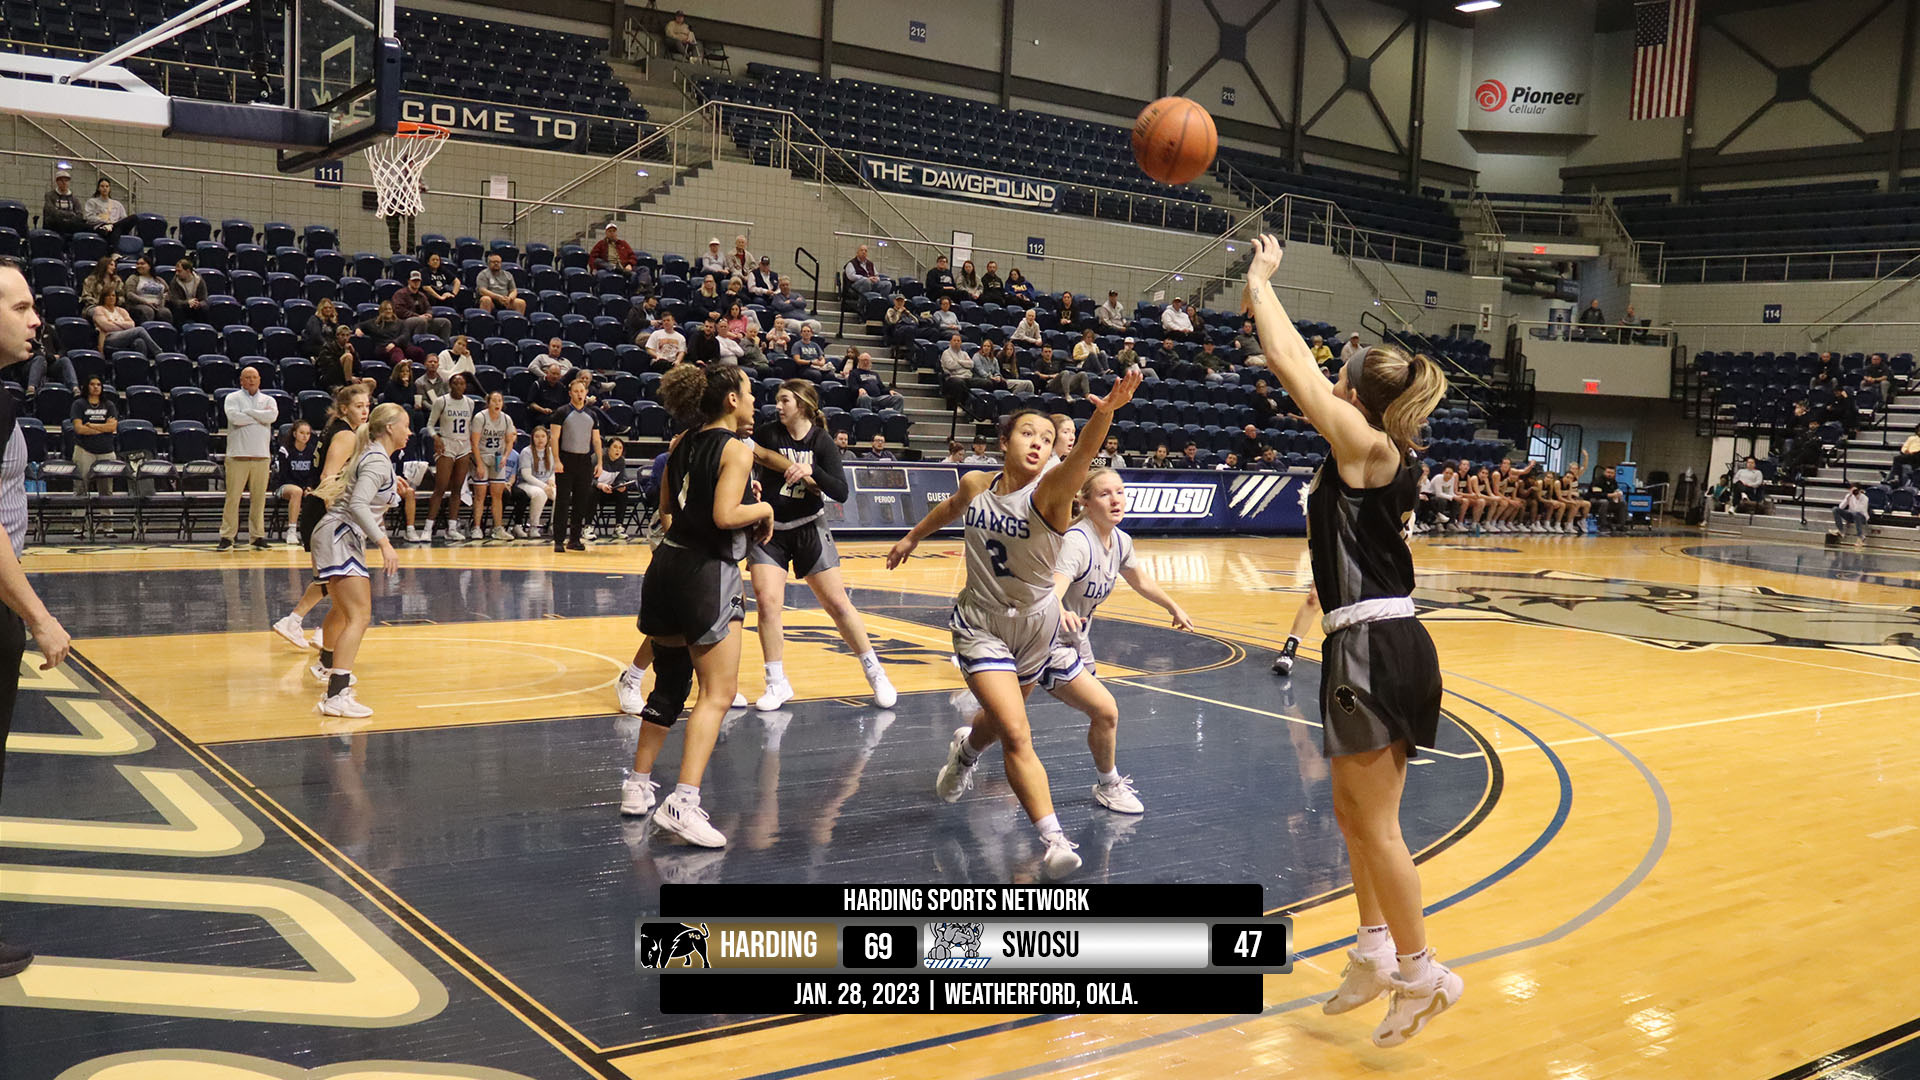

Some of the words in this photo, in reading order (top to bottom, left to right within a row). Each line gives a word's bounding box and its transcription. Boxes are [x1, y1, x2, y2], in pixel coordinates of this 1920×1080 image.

[911, 26, 926, 38] 212
[1223, 92, 1235, 101] 213
[1511, 86, 1584, 105] Pioneer
[1508, 103, 1547, 115] Cellular
[530, 115, 577, 141] TO
[319, 167, 341, 181] 111
[867, 160, 914, 183] THE
[921, 168, 1056, 202] DAWGPOUND
[1029, 243, 1044, 254] 112
[1426, 296, 1438, 305] 113
[1766, 310, 1780, 318] 114
[453, 419, 466, 433] 12
[485, 437, 500, 448] 23
[874, 495, 896, 504] PERIOD
[927, 492, 951, 502] GUEST
[965, 506, 1031, 539] DAWGS
[986, 539, 1016, 578] 2
